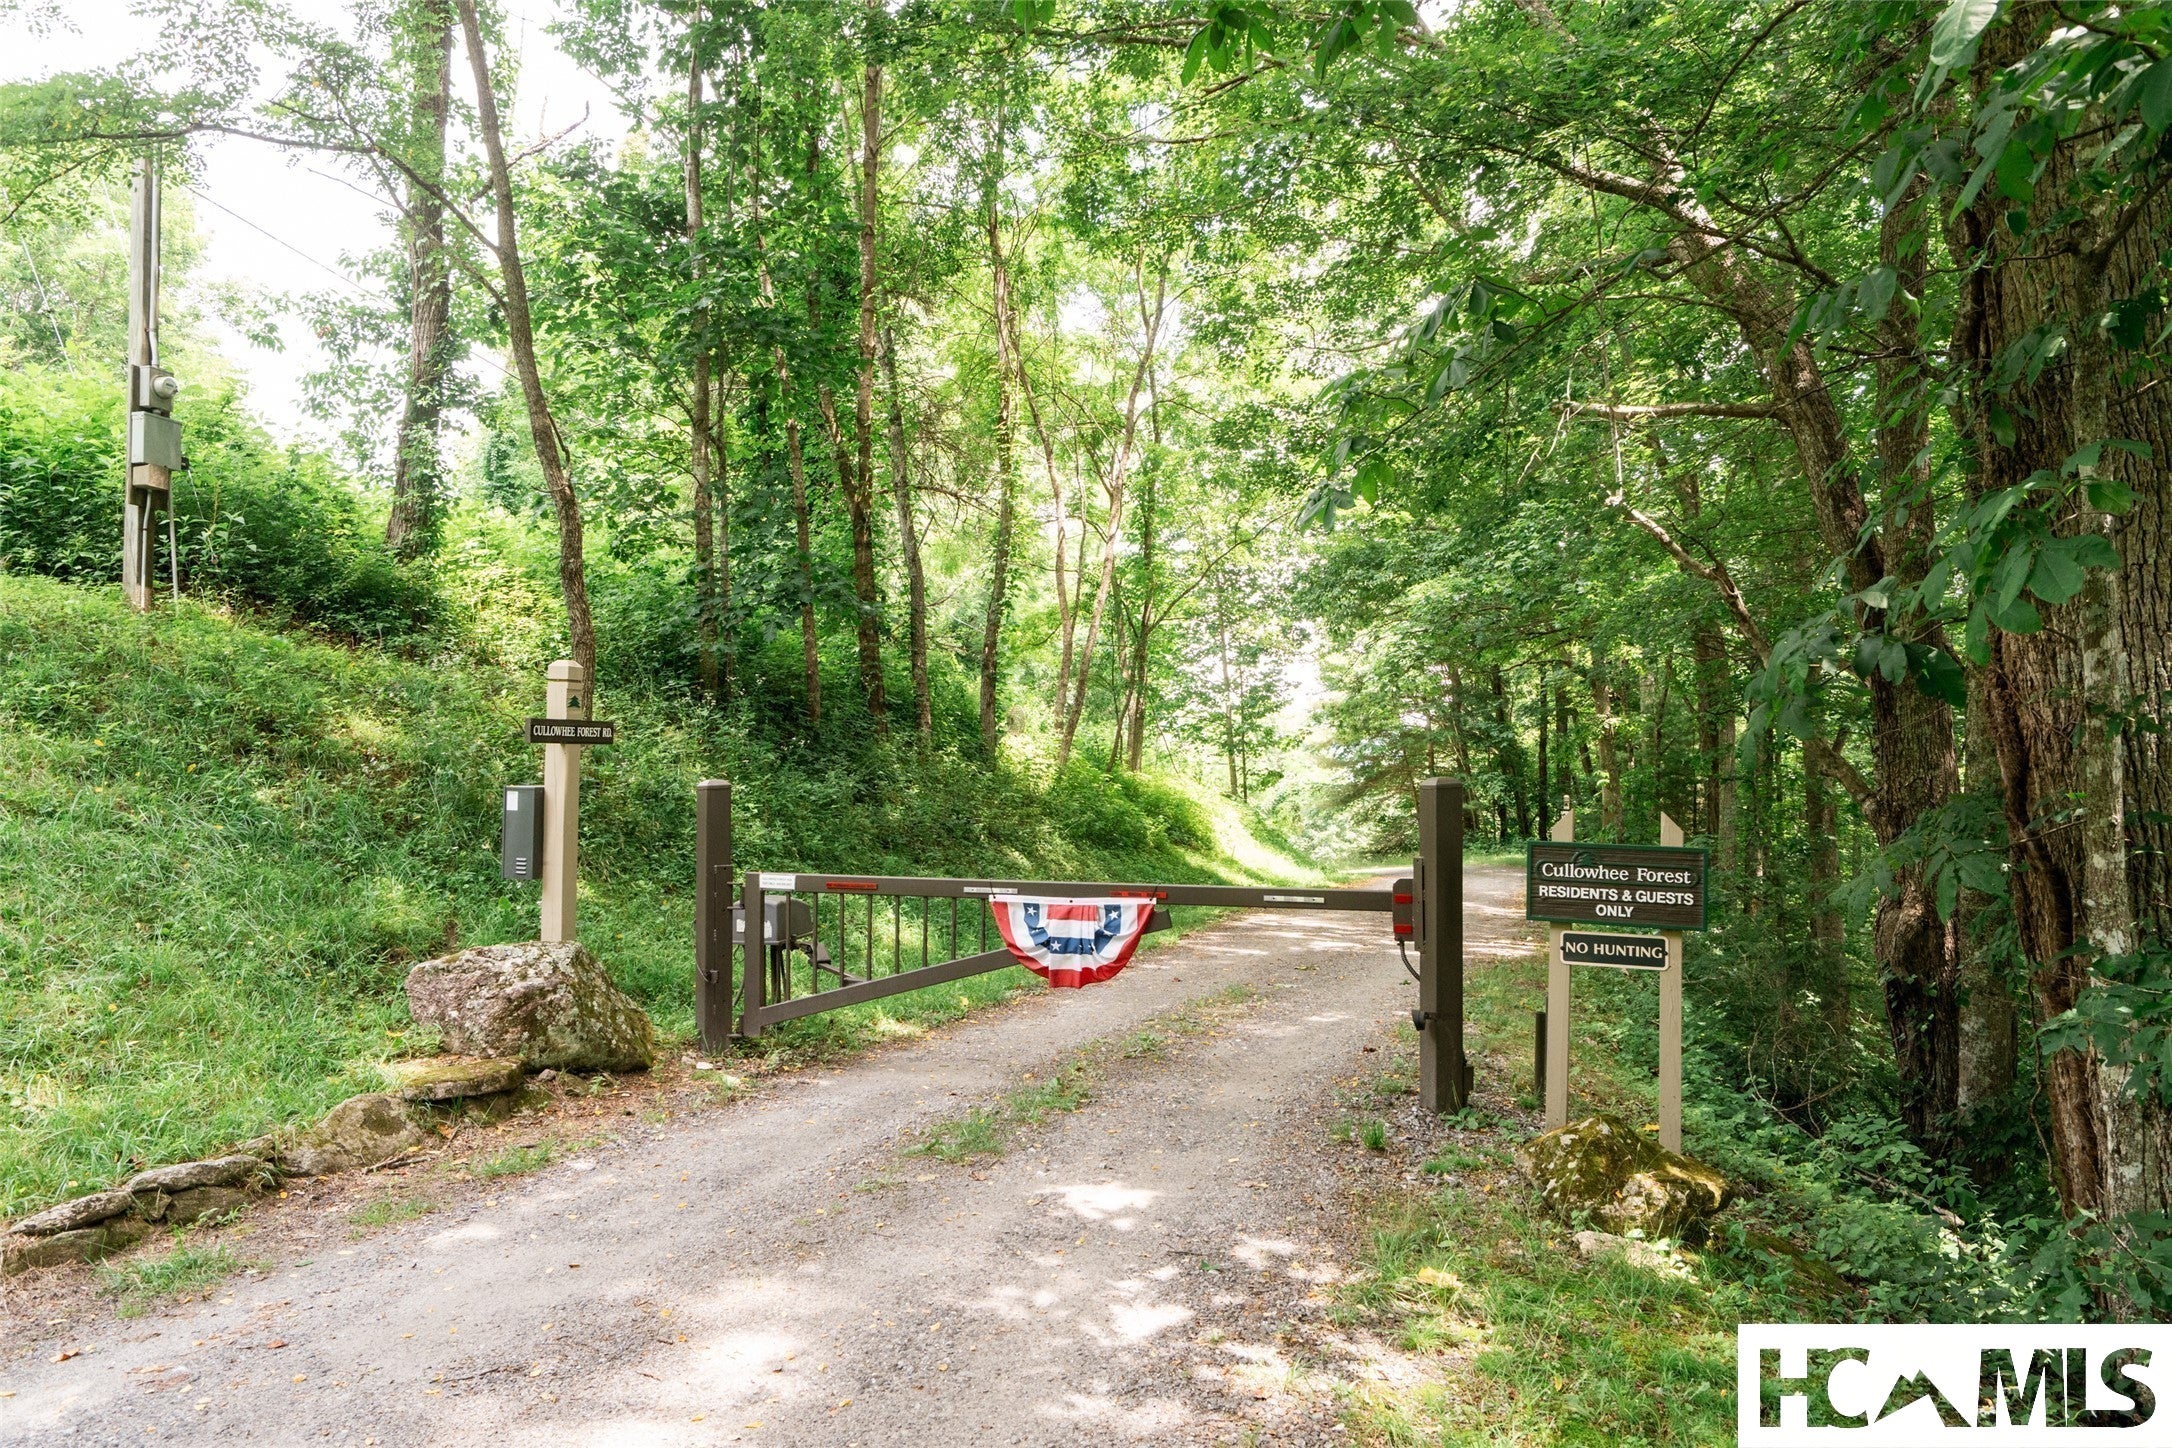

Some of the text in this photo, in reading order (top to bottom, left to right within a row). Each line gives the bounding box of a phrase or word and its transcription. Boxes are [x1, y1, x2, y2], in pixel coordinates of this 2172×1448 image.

[533, 725, 575, 736] CULLOWHEE
[577, 727, 601, 737] FOREST
[1542, 863, 1692, 884] Cullowhee Forest
[1539, 885, 1694, 905] RESIDENTS & GUESTS
[1595, 904, 1634, 917] ONLY
[1565, 941, 1663, 959] NO HUNTING
